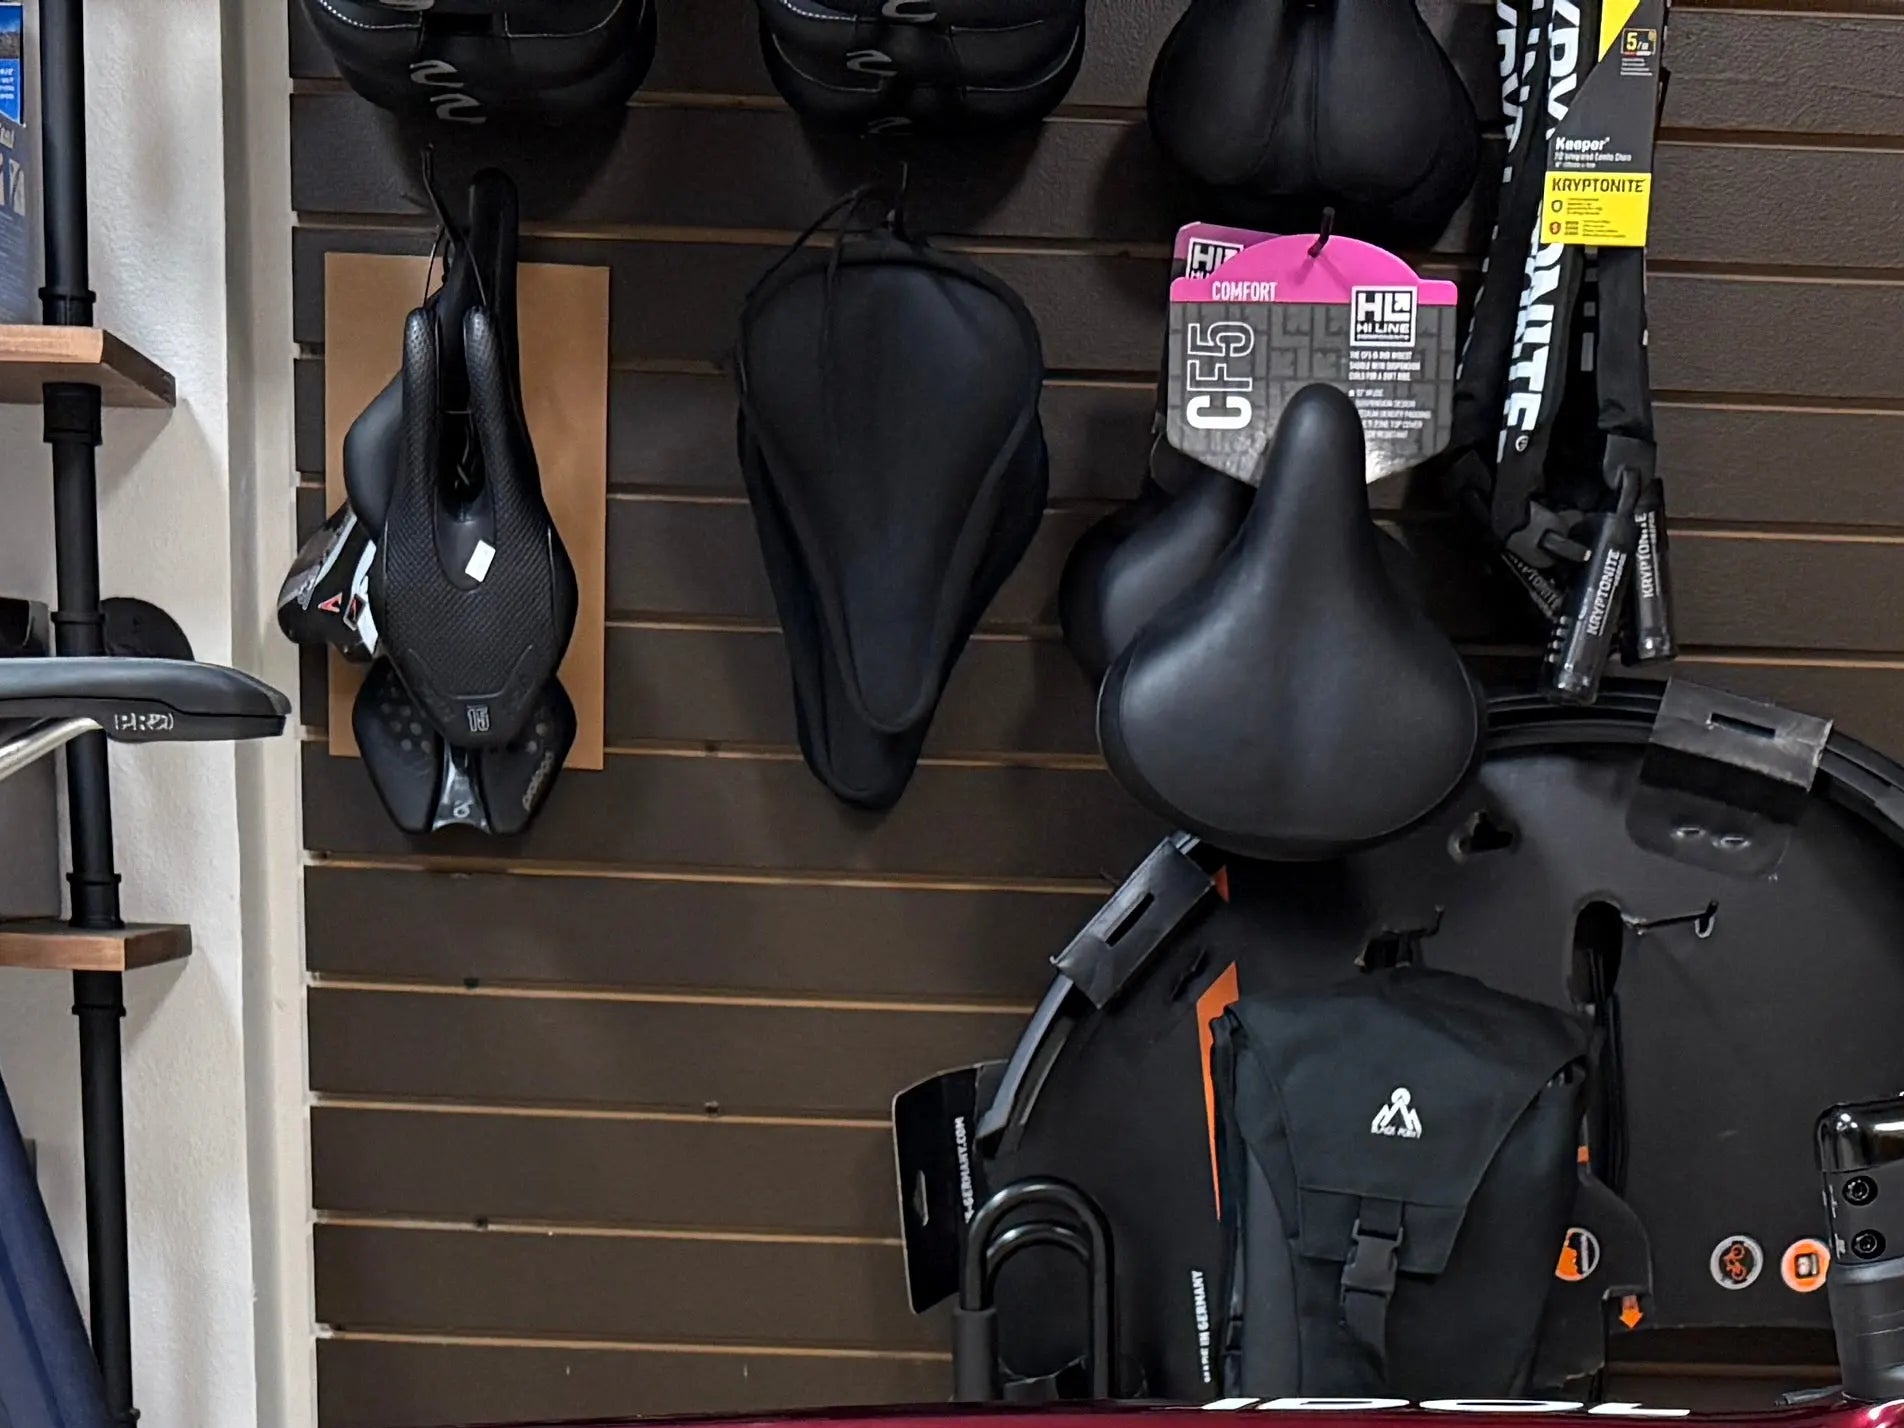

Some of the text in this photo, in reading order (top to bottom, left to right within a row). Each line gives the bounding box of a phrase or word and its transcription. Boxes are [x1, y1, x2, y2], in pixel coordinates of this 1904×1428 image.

[1552, 178, 1646, 193] KRYPTONITE
[1212, 281, 1279, 301] COMFORT
[1186, 321, 1255, 430] CF5
[1587, 548, 1621, 636] KRYPTONITE
[1635, 512, 1655, 599] KRYPTONTE
[1192, 1270, 1209, 1330] GERMANY
